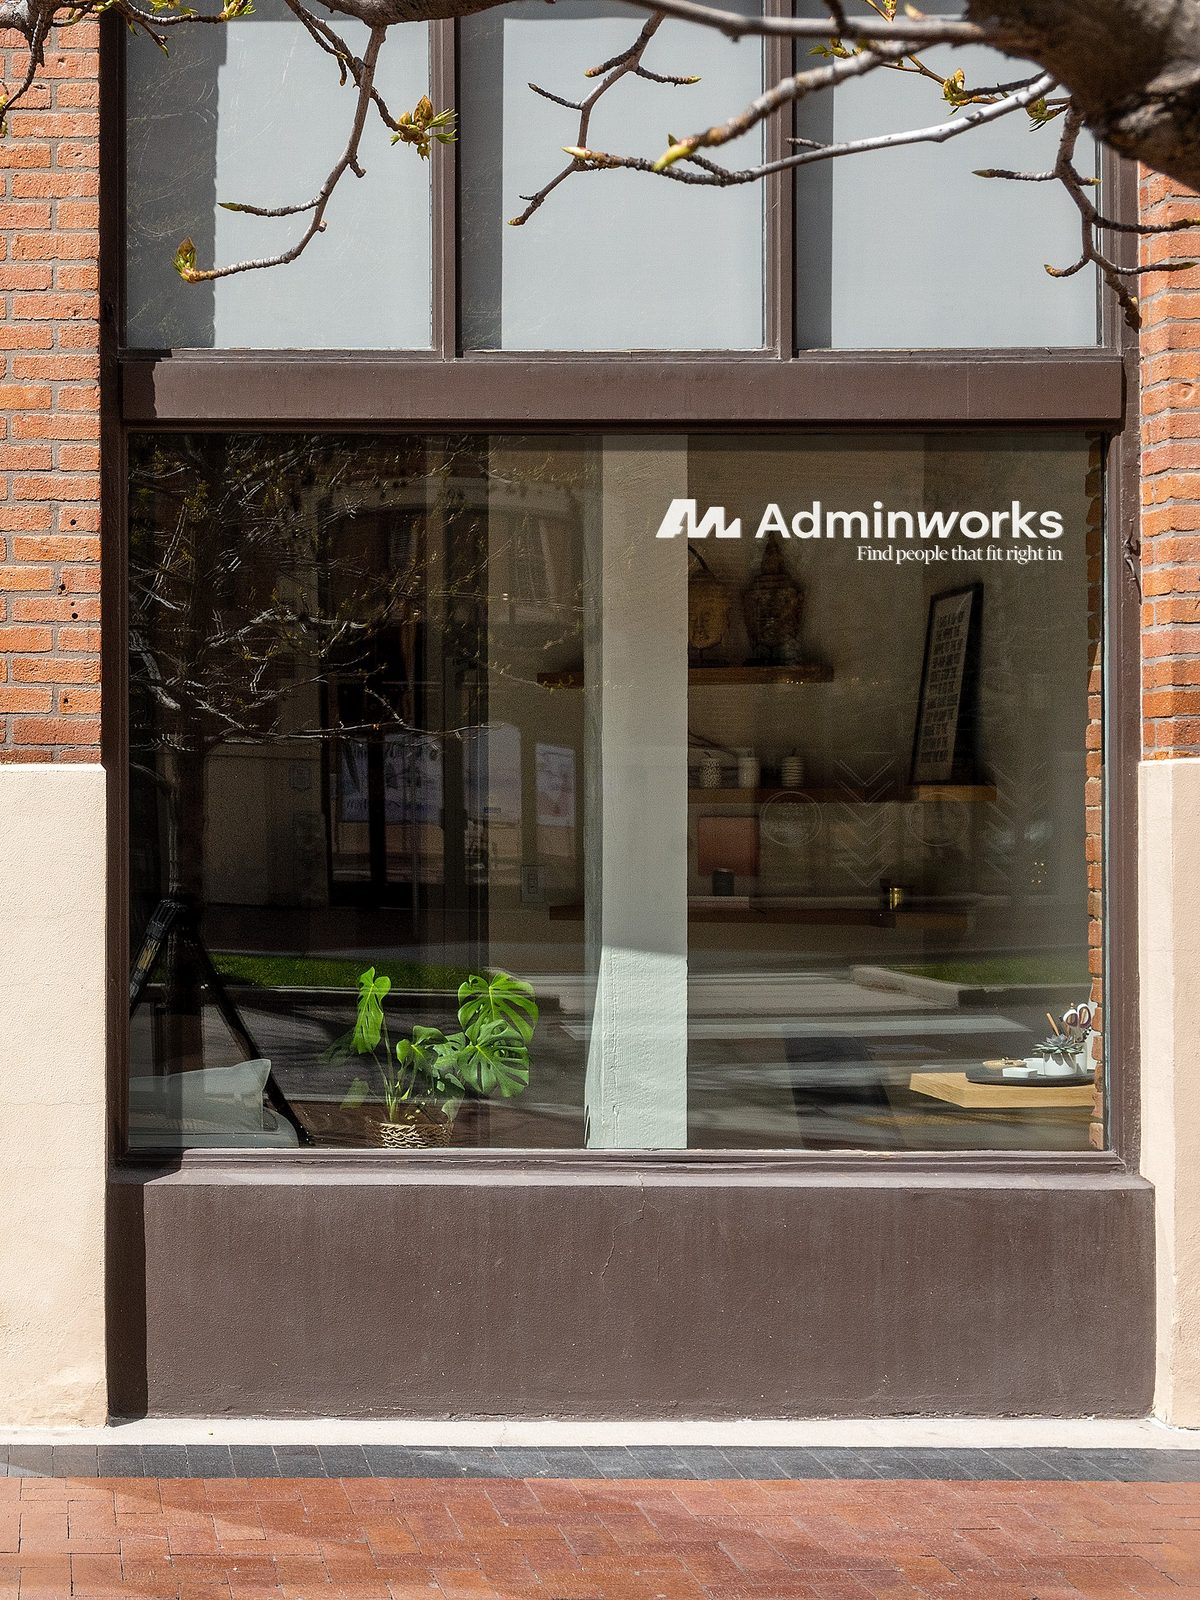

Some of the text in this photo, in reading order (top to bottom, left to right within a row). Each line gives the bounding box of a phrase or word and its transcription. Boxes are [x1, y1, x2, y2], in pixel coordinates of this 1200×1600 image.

[754, 500, 1064, 540] Adminworks
[856, 545, 1063, 565] Find people that fit right in
